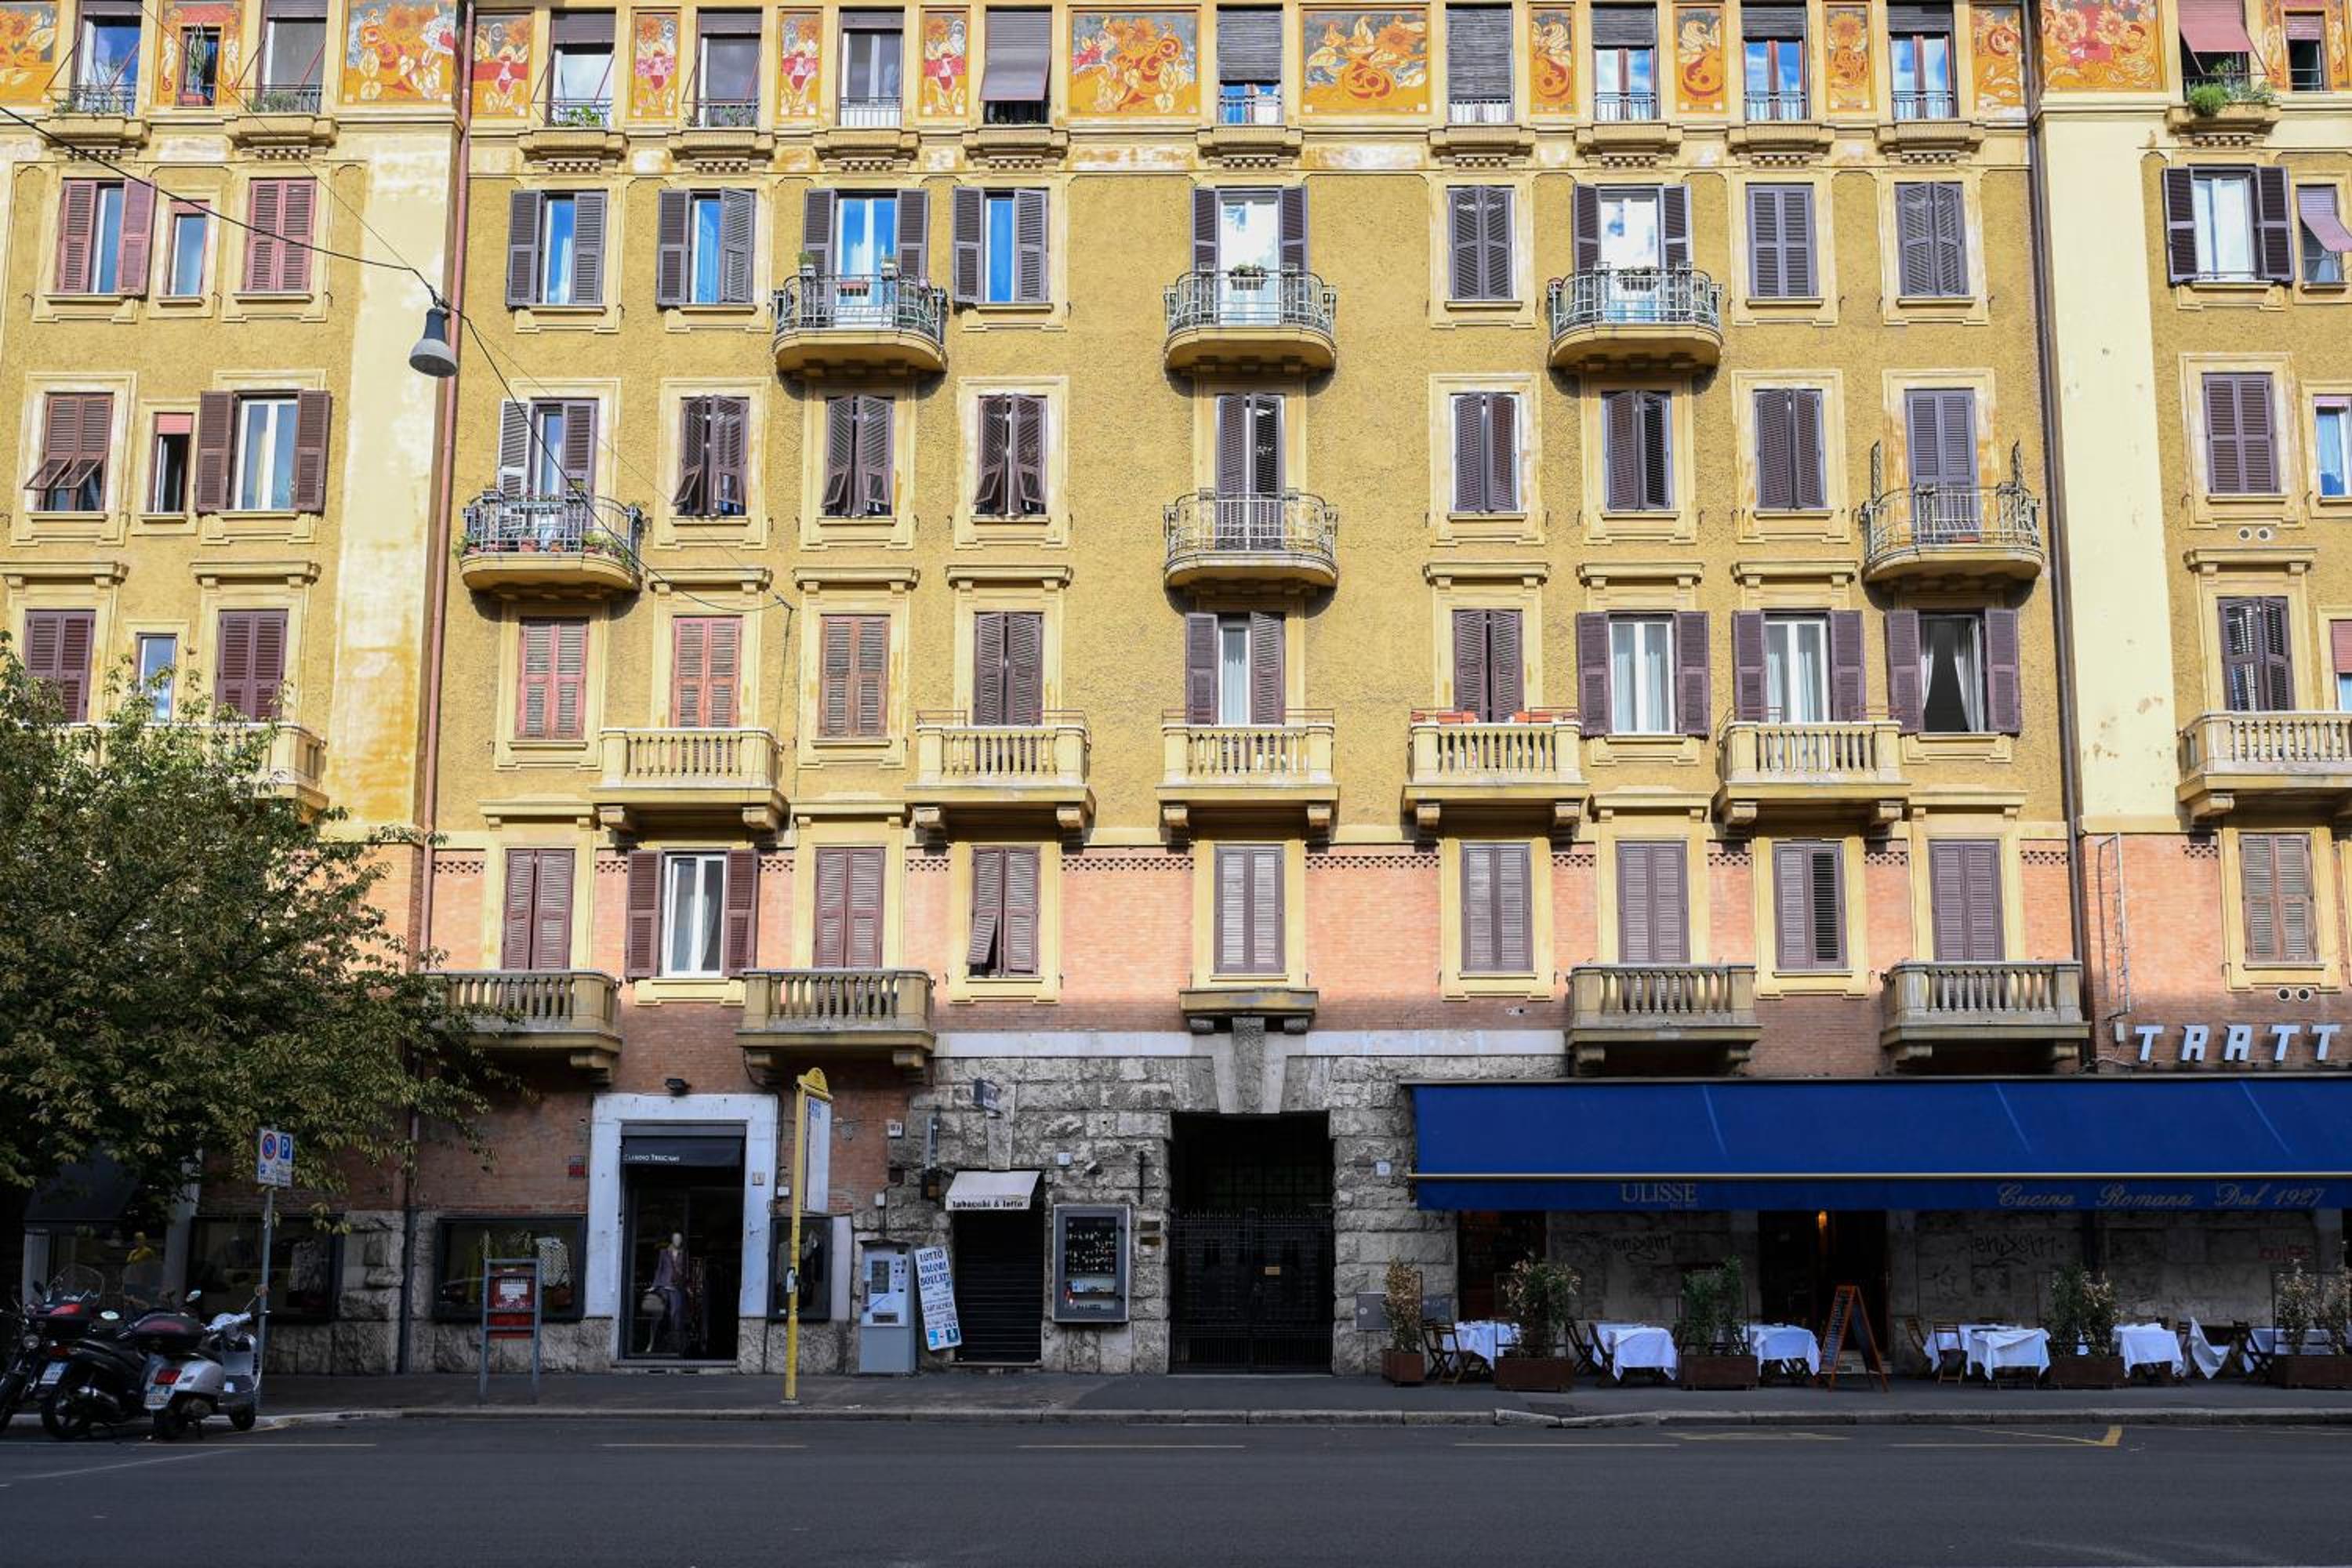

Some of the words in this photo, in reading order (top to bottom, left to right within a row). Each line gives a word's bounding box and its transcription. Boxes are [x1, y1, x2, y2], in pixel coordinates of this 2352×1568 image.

[1621, 1182, 1697, 1203] ULISSE
[1997, 1182, 2076, 1207] Cucina
[2095, 1181, 2196, 1207] Romana
[2214, 1182, 2271, 1207] Dal
[920, 1250, 943, 1262] LOTTO
